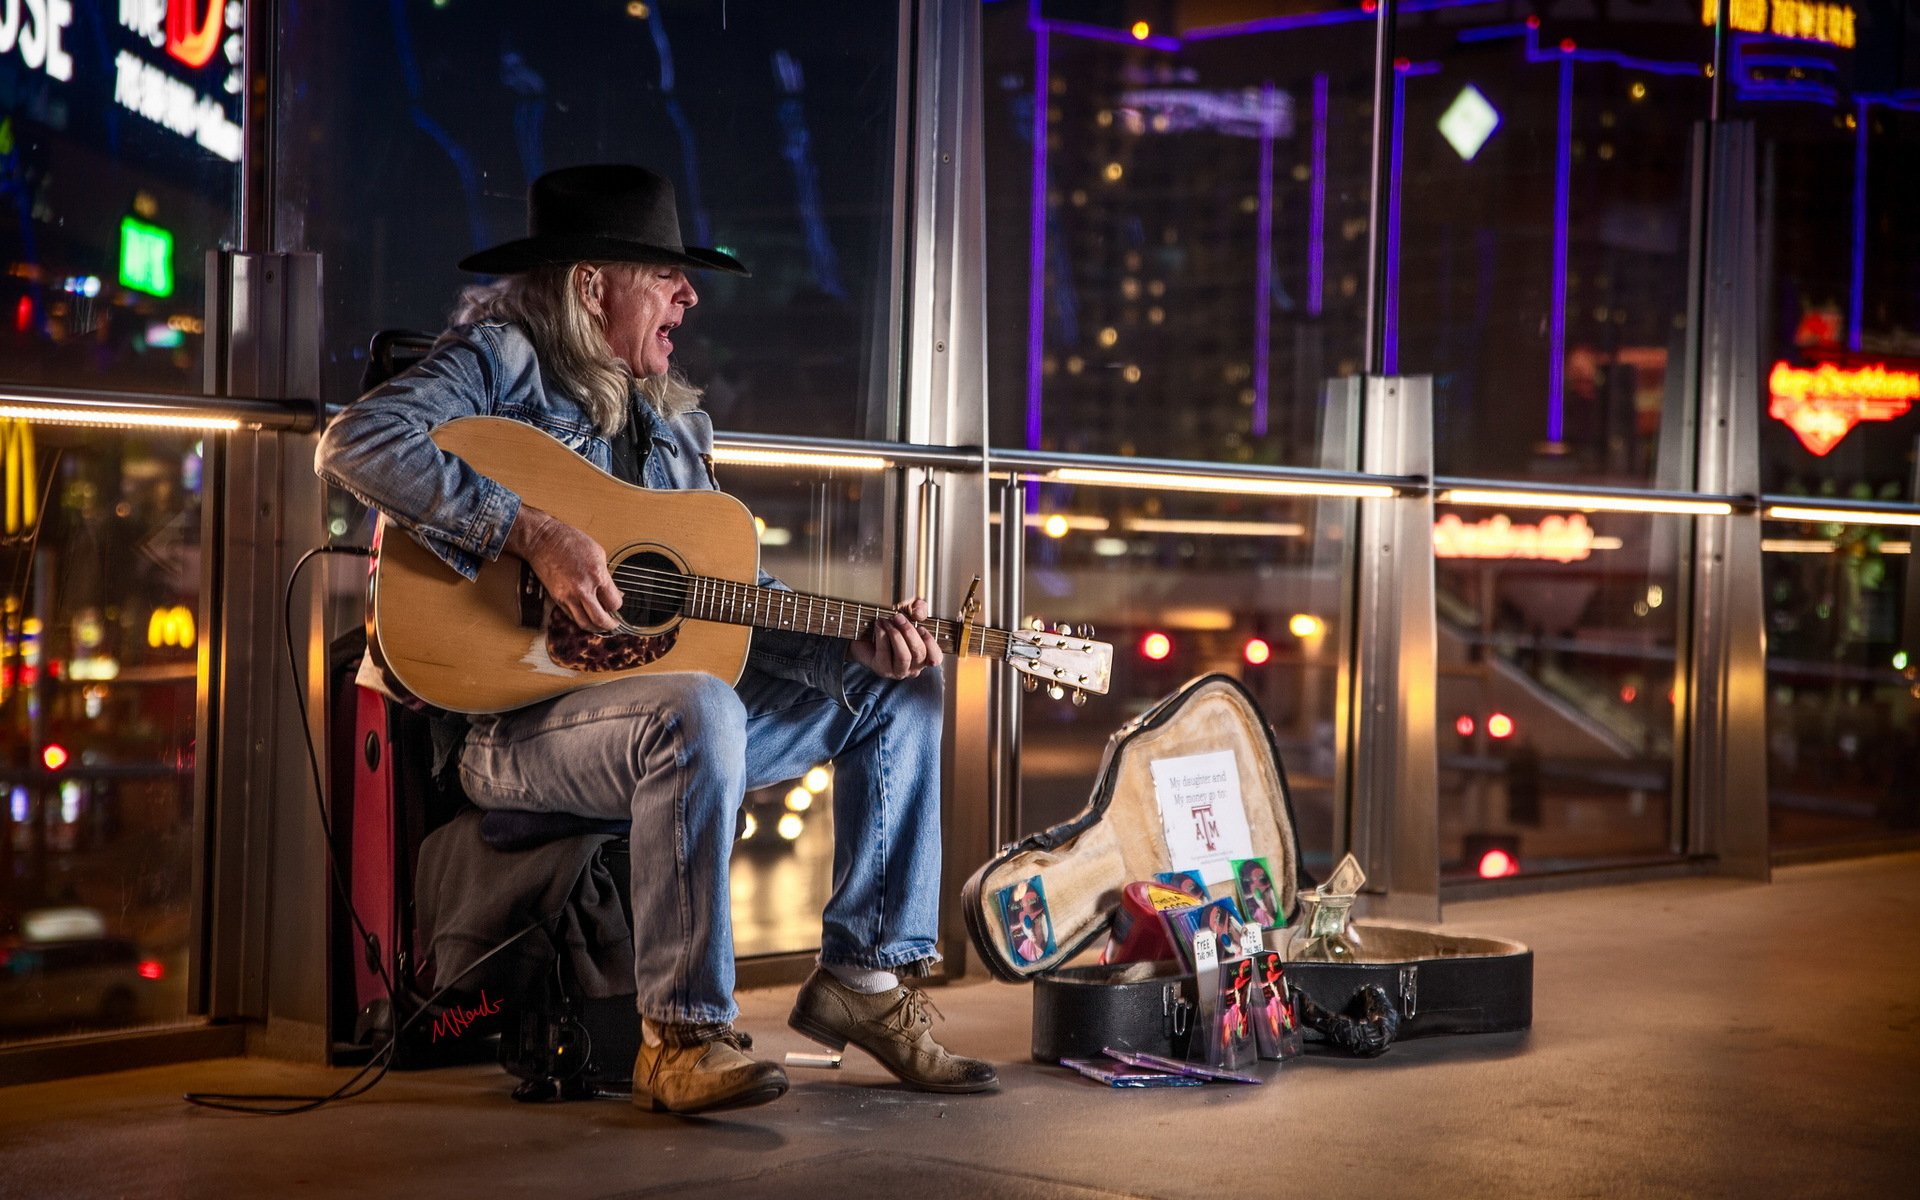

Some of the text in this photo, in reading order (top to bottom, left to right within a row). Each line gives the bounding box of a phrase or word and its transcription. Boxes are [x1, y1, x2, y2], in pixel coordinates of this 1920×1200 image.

[1169, 770, 1227, 791] My daughter and
[1174, 793, 1184, 808] My
[1186, 791, 1208, 805] money
